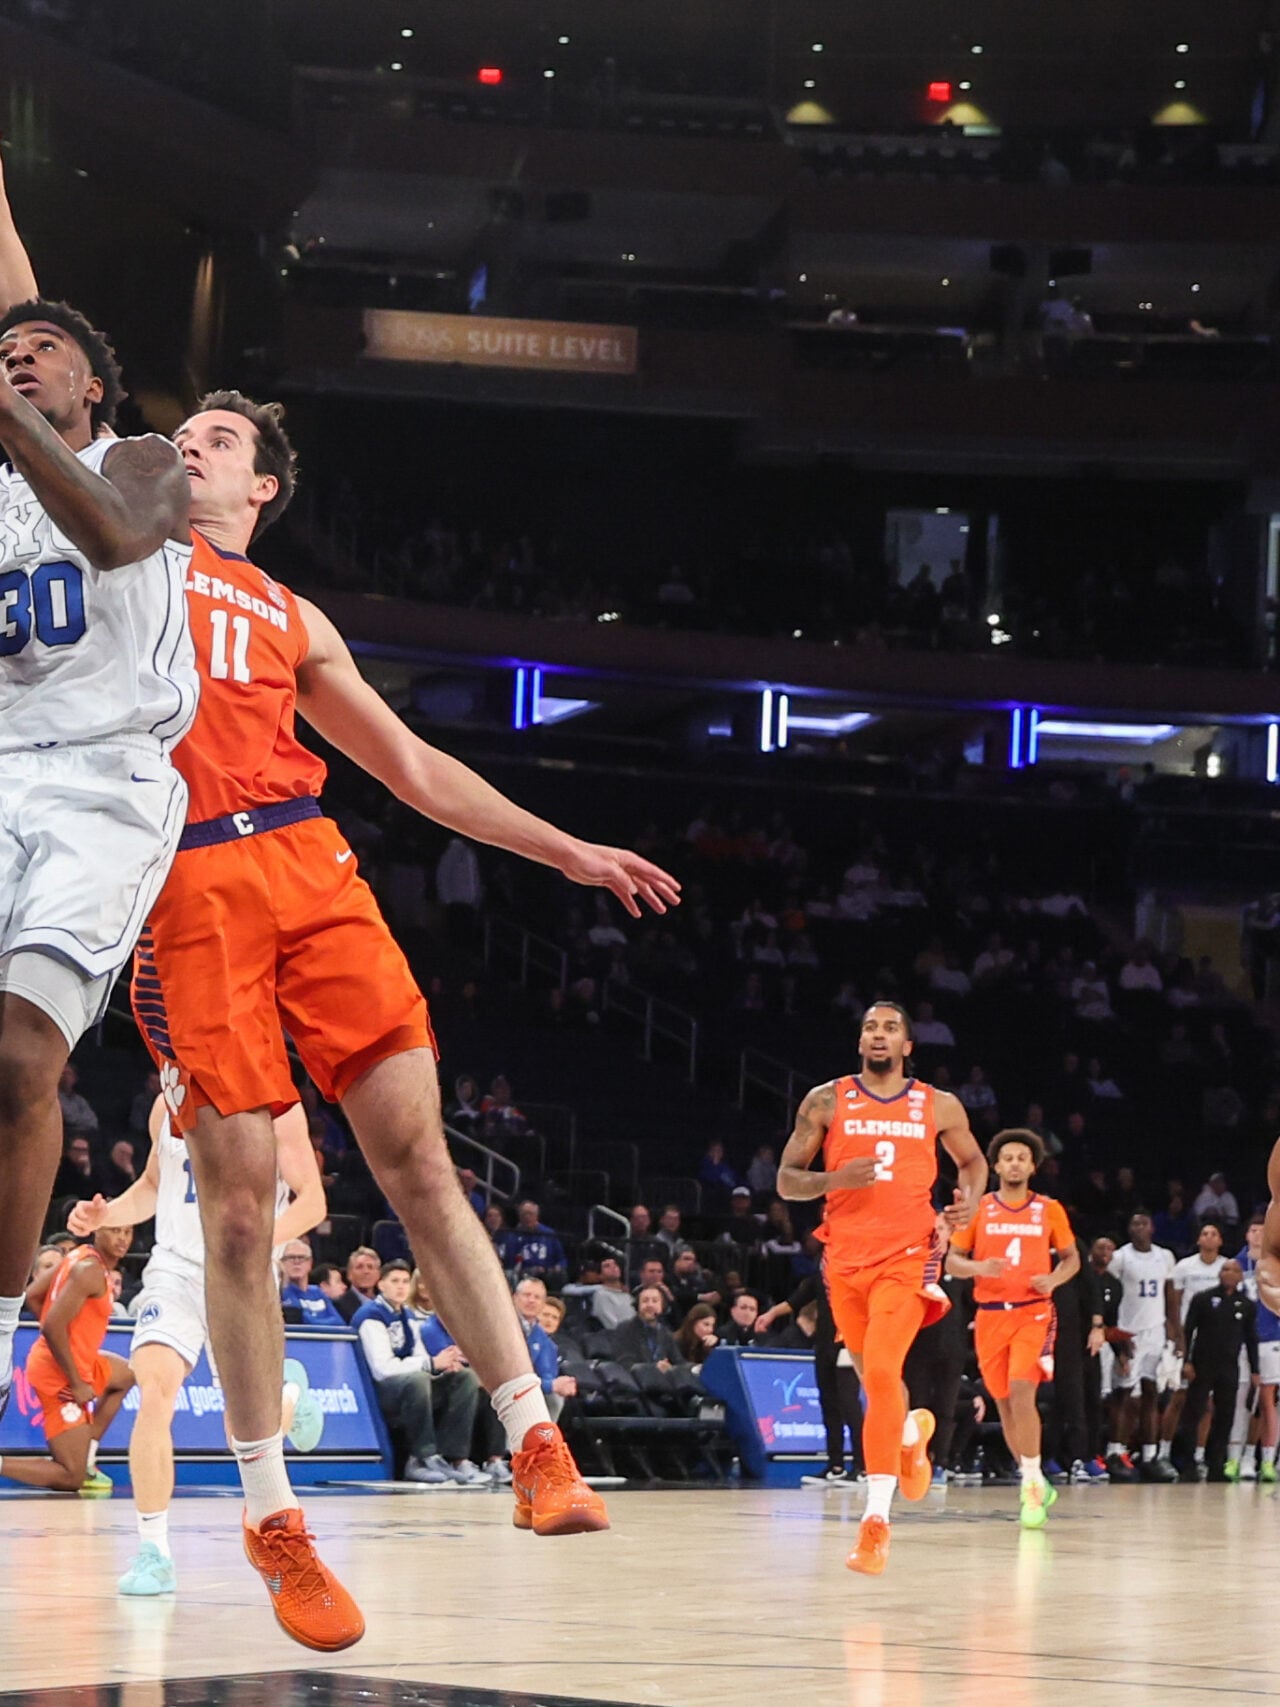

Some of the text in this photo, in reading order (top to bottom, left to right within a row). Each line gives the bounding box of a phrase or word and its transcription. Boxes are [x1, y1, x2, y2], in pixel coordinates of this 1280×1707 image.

[467, 330, 540, 356] SUITE
[549, 336, 626, 362] LEVEL
[210, 609, 251, 684] 11
[232, 811, 254, 836] C
[843, 1119, 926, 1140] CLEMSON
[873, 1140, 896, 1181] 2
[1005, 1237, 1022, 1266] 4
[1138, 1279, 1158, 1297] 13
